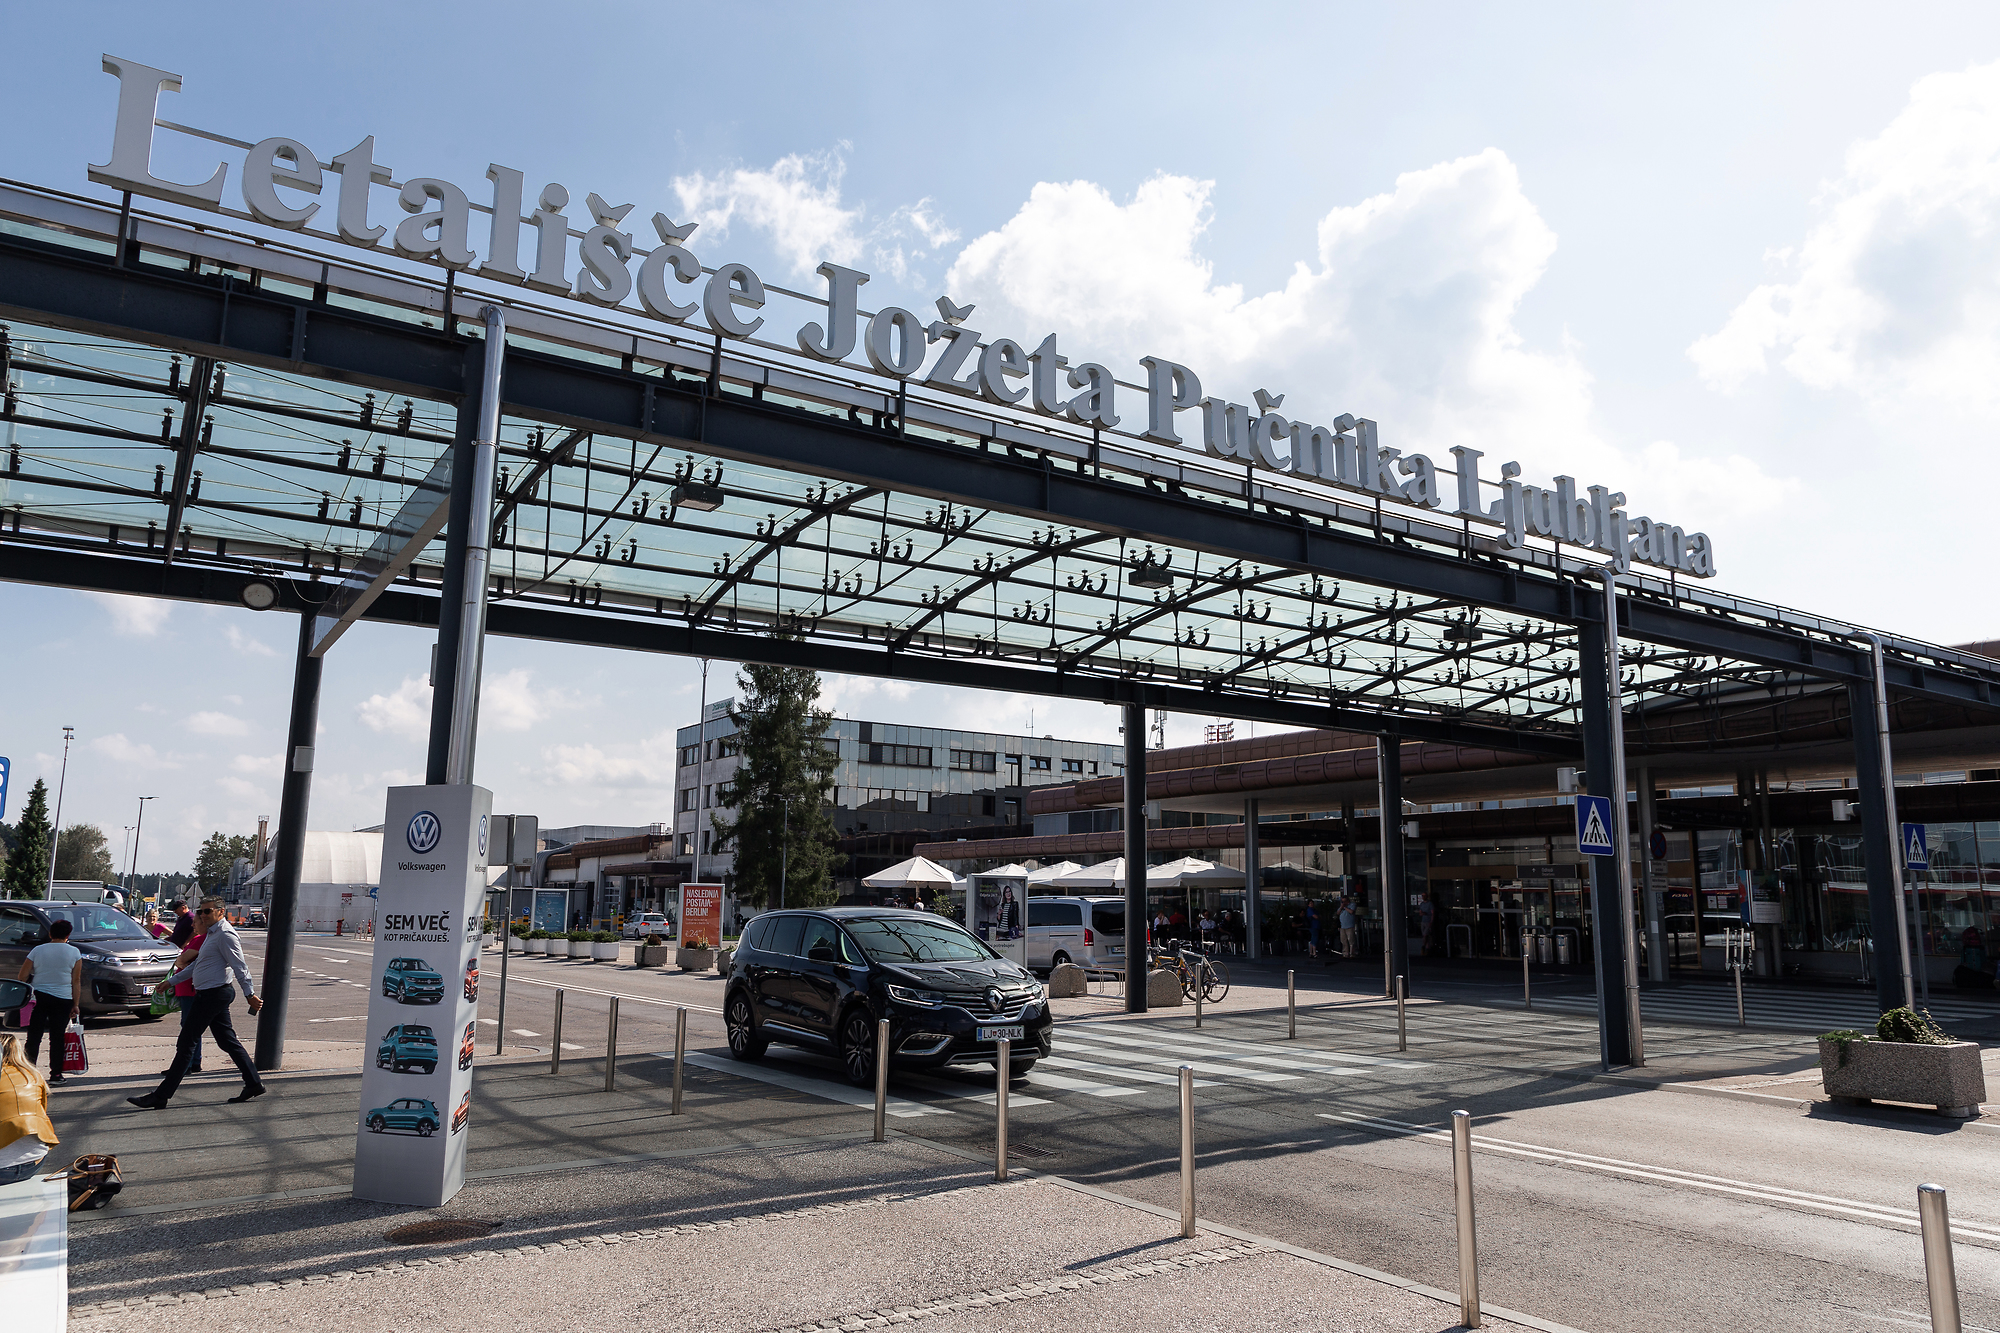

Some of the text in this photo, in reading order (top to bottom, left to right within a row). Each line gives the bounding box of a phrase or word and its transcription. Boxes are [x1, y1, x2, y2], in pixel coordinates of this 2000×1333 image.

[87, 53, 1717, 579] Letališče Jožeta Pučnika Ljubljana
[398, 862, 446, 873] Volkswagen
[685, 907, 709, 916] BERLIN!
[384, 911, 451, 933] SEM VEČ,
[384, 931, 450, 943] KOT PRIČAKUJEŠ.
[983, 1028, 1023, 1039] LJ 30-NLK
[64, 1042, 81, 1051] UTY
